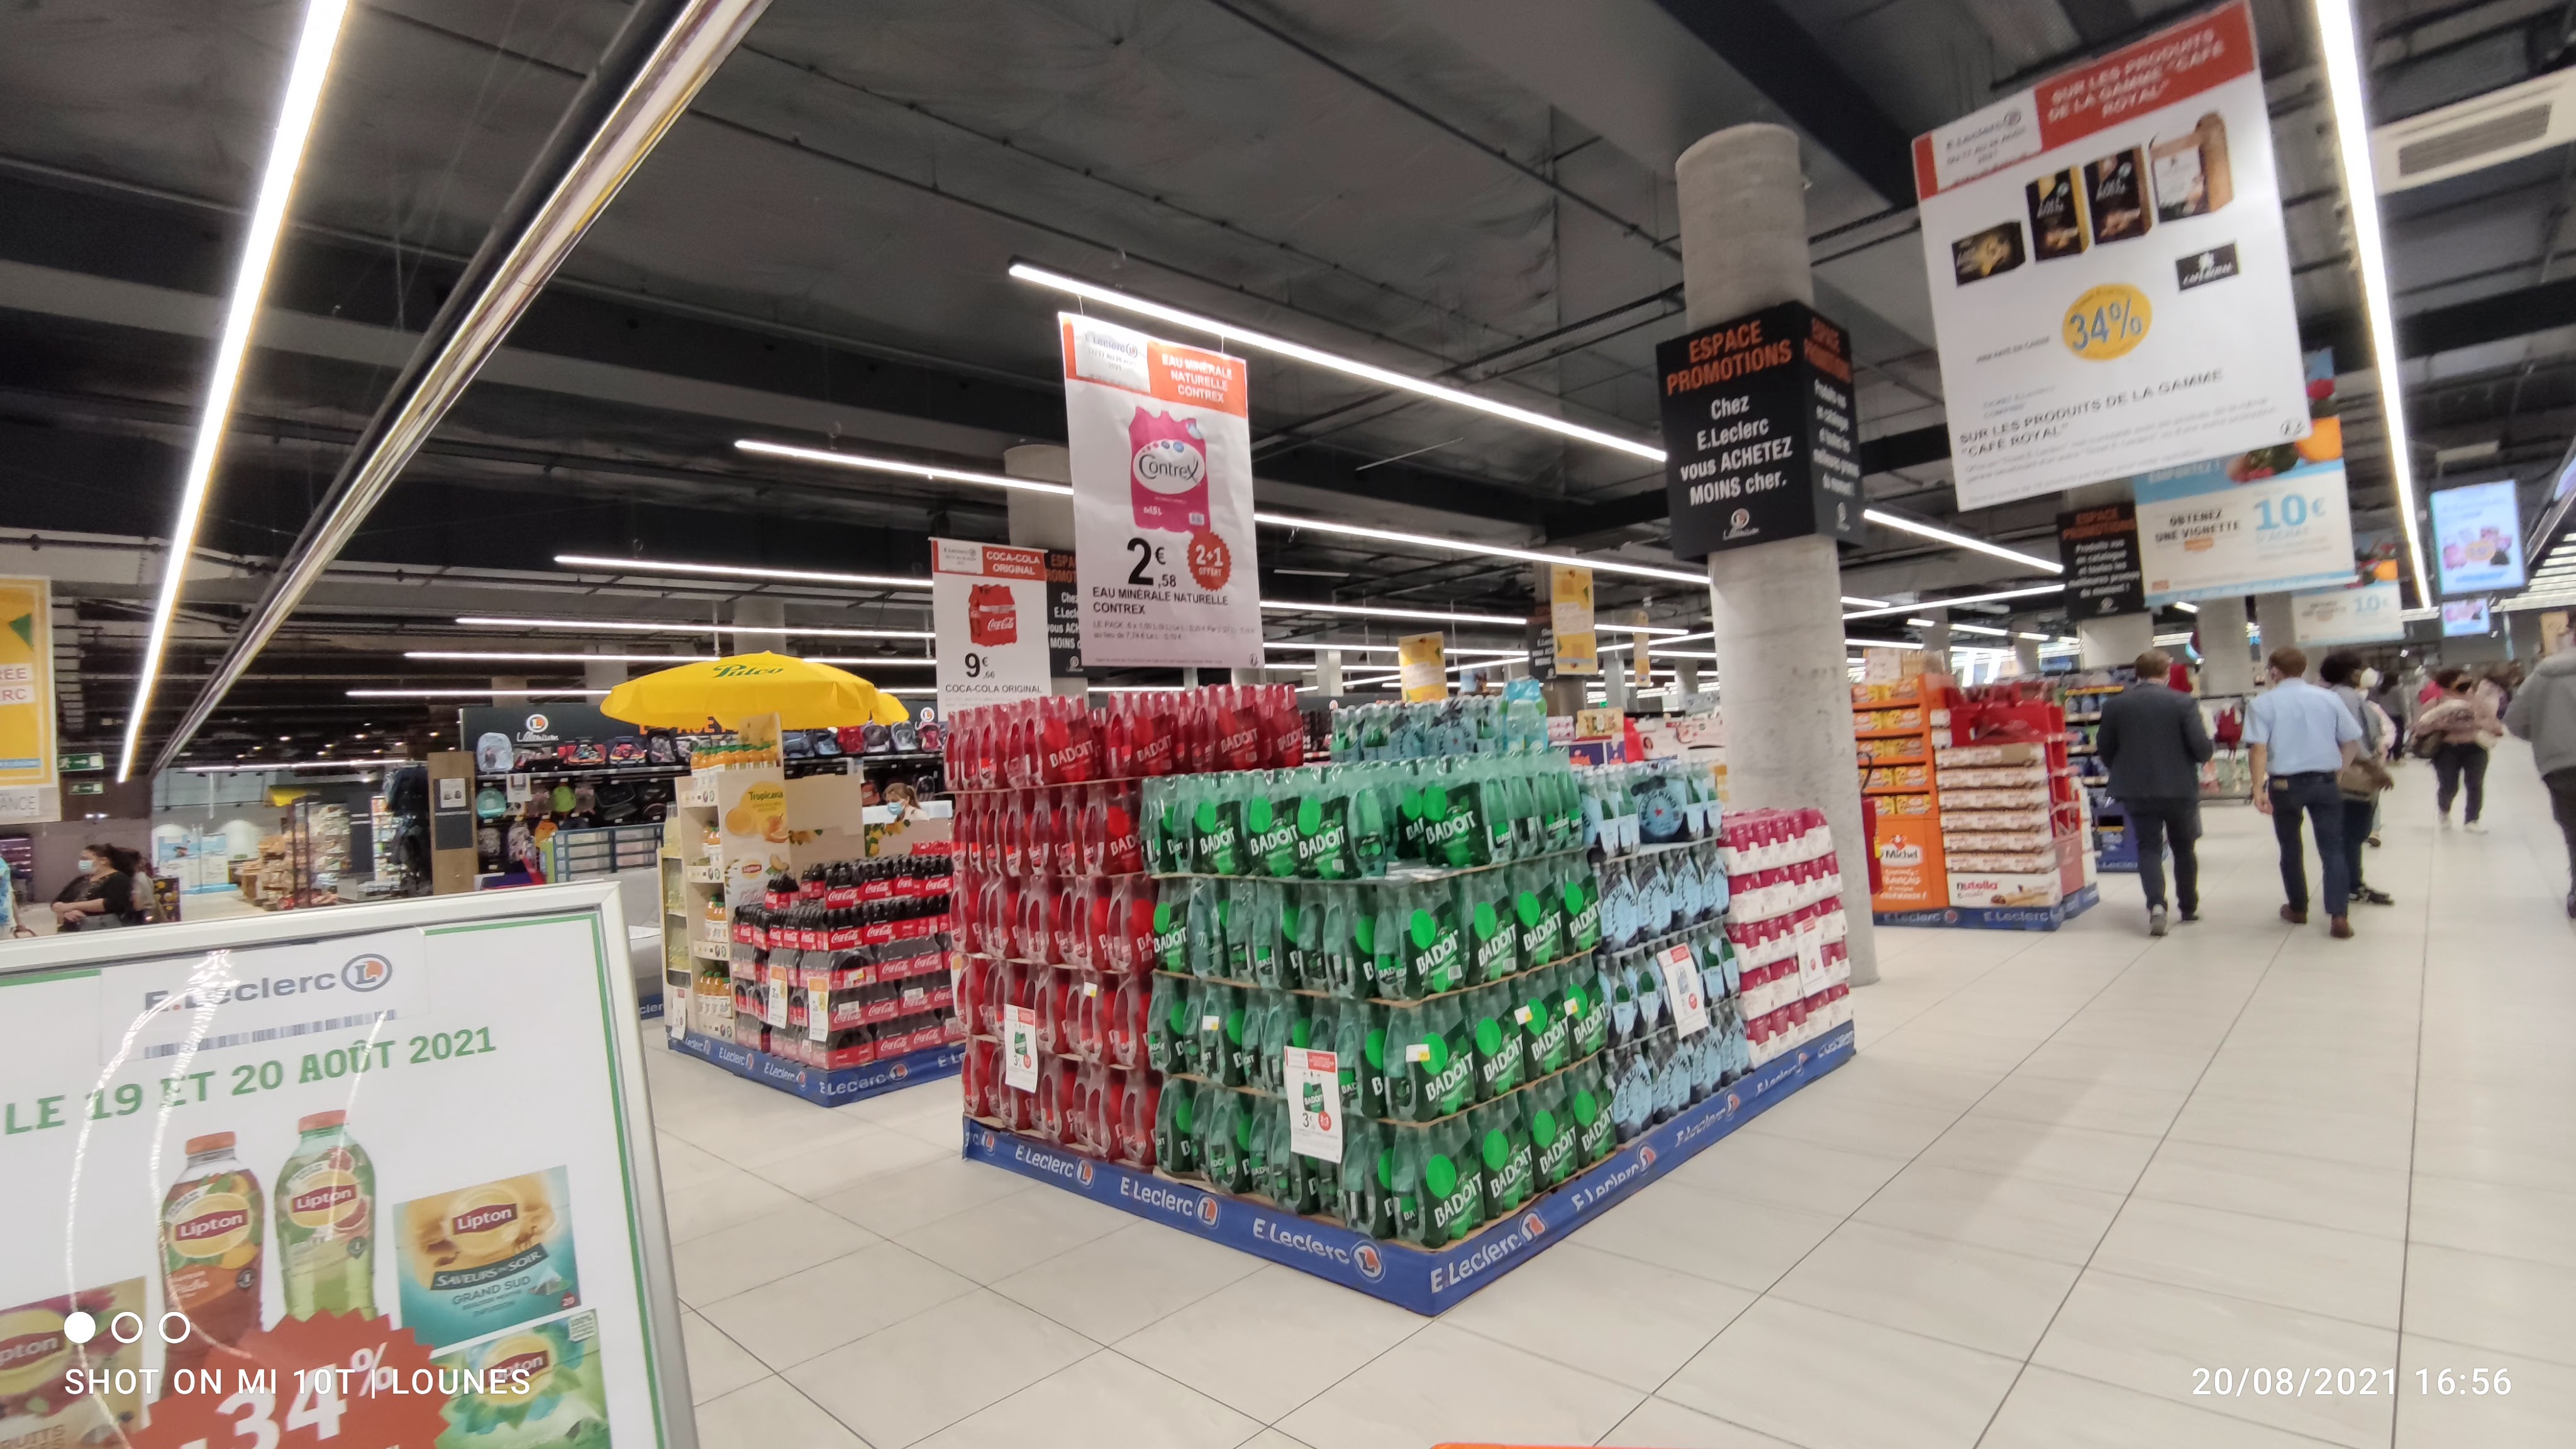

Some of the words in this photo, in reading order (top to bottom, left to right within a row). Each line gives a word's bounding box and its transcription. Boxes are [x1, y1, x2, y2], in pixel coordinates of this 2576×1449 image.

[2070, 298, 2142, 351] 34%
[1689, 321, 1762, 364] ESPACE
[1162, 353, 1183, 368] EAU
[1667, 339, 1792, 396] PROMOTIONS
[1170, 370, 1228, 392] NATURELLE
[1177, 384, 1224, 403] CONTREX
[1711, 395, 1750, 419] Chez
[1993, 419, 2019, 438] LES
[2024, 397, 2102, 430] PRODUITS
[2106, 395, 2127, 411] DE
[2133, 387, 2154, 402] LA
[2158, 369, 2224, 396] GAMME
[1697, 418, 1770, 452] E.Leclerc
[1680, 460, 1716, 482] vous
[1721, 436, 1793, 473] ACHETEZ
[1690, 476, 1741, 506] MOINS
[1745, 470, 1787, 496] cher.
[2170, 508, 2223, 527] OBTENEZ
[2254, 492, 2307, 531] 10
[2155, 530, 2178, 543] UNE
[2184, 519, 2240, 538] VIGNETTE
[986, 551, 1040, 564] COCA-COLA
[992, 563, 1036, 575] ORIGINAL
[1051, 554, 1076, 567] ESPA
[1127, 537, 1154, 586] 2
[1155, 547, 1167, 565] €
[1092, 586, 1116, 598] EAU
[1174, 592, 1229, 606] NATURELLE
[1093, 602, 1146, 615] CONTREX
[1050, 638, 1075, 649] MOINS
[713, 663, 784, 679] Pulco
[965, 653, 980, 678] 9
[945, 684, 999, 693] COCA-COLA
[1002, 685, 1043, 693] ORIGINAL
[1050, 739, 1094, 768] BADOIT
[1136, 735, 1173, 762] BADOIT
[1221, 727, 1258, 753] BADOIT
[748, 791, 784, 802] Tropicana
[1200, 826, 1235, 855] BADOIT
[1250, 823, 1299, 857] BADOIT
[1299, 824, 1345, 860] BADOIT
[1425, 810, 1476, 845] BADOIT
[1111, 834, 1137, 857] BAD
[1957, 880, 1998, 891] nutella
[1523, 911, 1562, 952] BADOIT
[1569, 901, 1600, 938] BADOIT
[1153, 926, 1187, 953] BADOIT
[1416, 930, 1458, 975] BADOI
[1478, 923, 1517, 967] BADOIT
[1573, 1002, 1606, 1044] BADOIT
[1531, 1018, 1569, 1061] BADOIT
[1483, 1033, 1524, 1082] BADOIT
[5, 1095, 65, 1135] LE
[86, 1083, 143, 1121] 19
[160, 1070, 216, 1108] ET
[231, 1060, 284, 1096] 20
[299, 1039, 396, 1084] AOÛT
[409, 1026, 497, 1064] 2021
[1425, 1052, 1474, 1102] BADOIT
[1302, 1112, 1309, 1128] 3
[1581, 1105, 1614, 1152] BADOIT
[1539, 1125, 1577, 1175] BADOIT
[1490, 1144, 1532, 1198] BADOIT
[297, 1187, 352, 1209] Lipton
[1434, 1171, 1482, 1228] BADOIT
[180, 1213, 243, 1237] Lipton
[457, 1207, 513, 1231] Lipton
[436, 1267, 498, 1287] SAVEURS
[508, 1250, 542, 1271] SOIR
[452, 1283, 501, 1306] GRAND
[504, 1275, 531, 1291] SUD
[0, 1336, 58, 1366] pton
